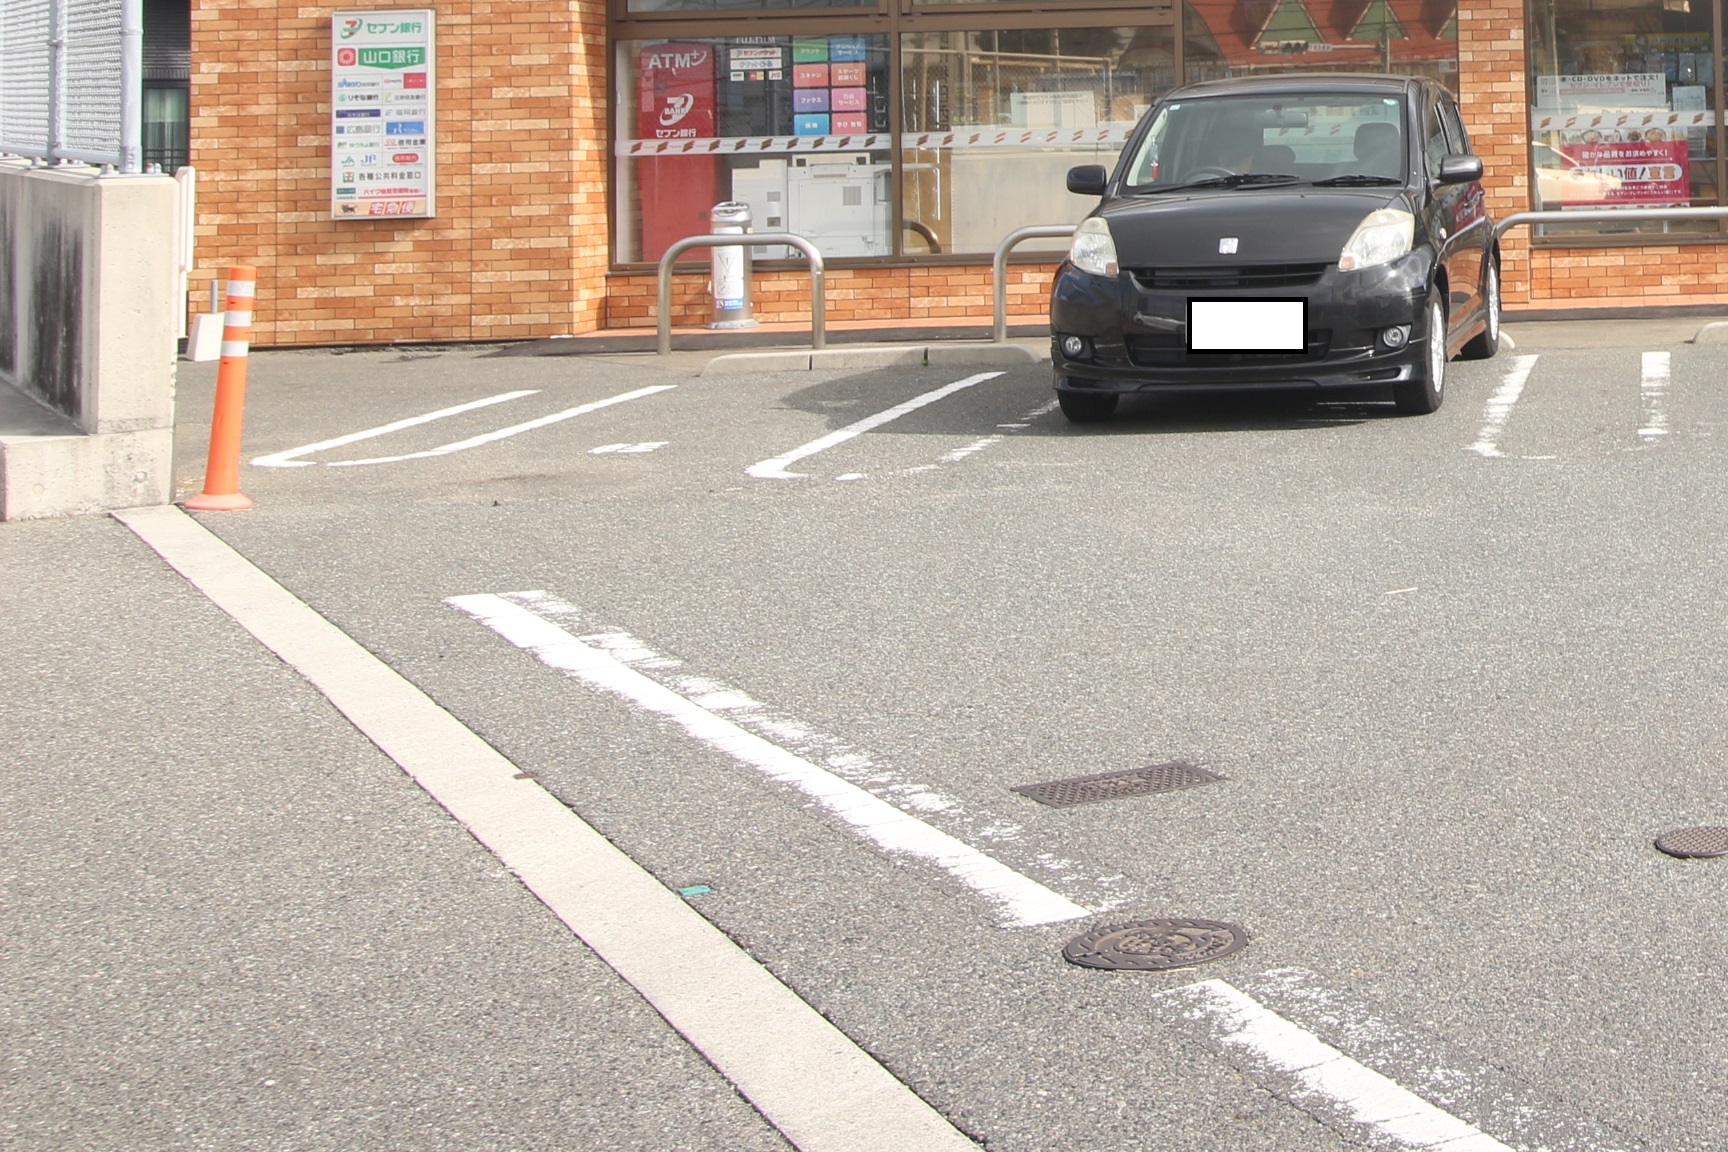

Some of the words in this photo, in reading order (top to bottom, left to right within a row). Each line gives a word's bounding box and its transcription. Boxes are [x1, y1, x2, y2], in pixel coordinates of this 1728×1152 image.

[366, 22, 422, 35] セブン銀行
[363, 49, 420, 64] 山口銀行
[655, 128, 696, 138] セブン銀行
[370, 201, 415, 215] 宅急便
